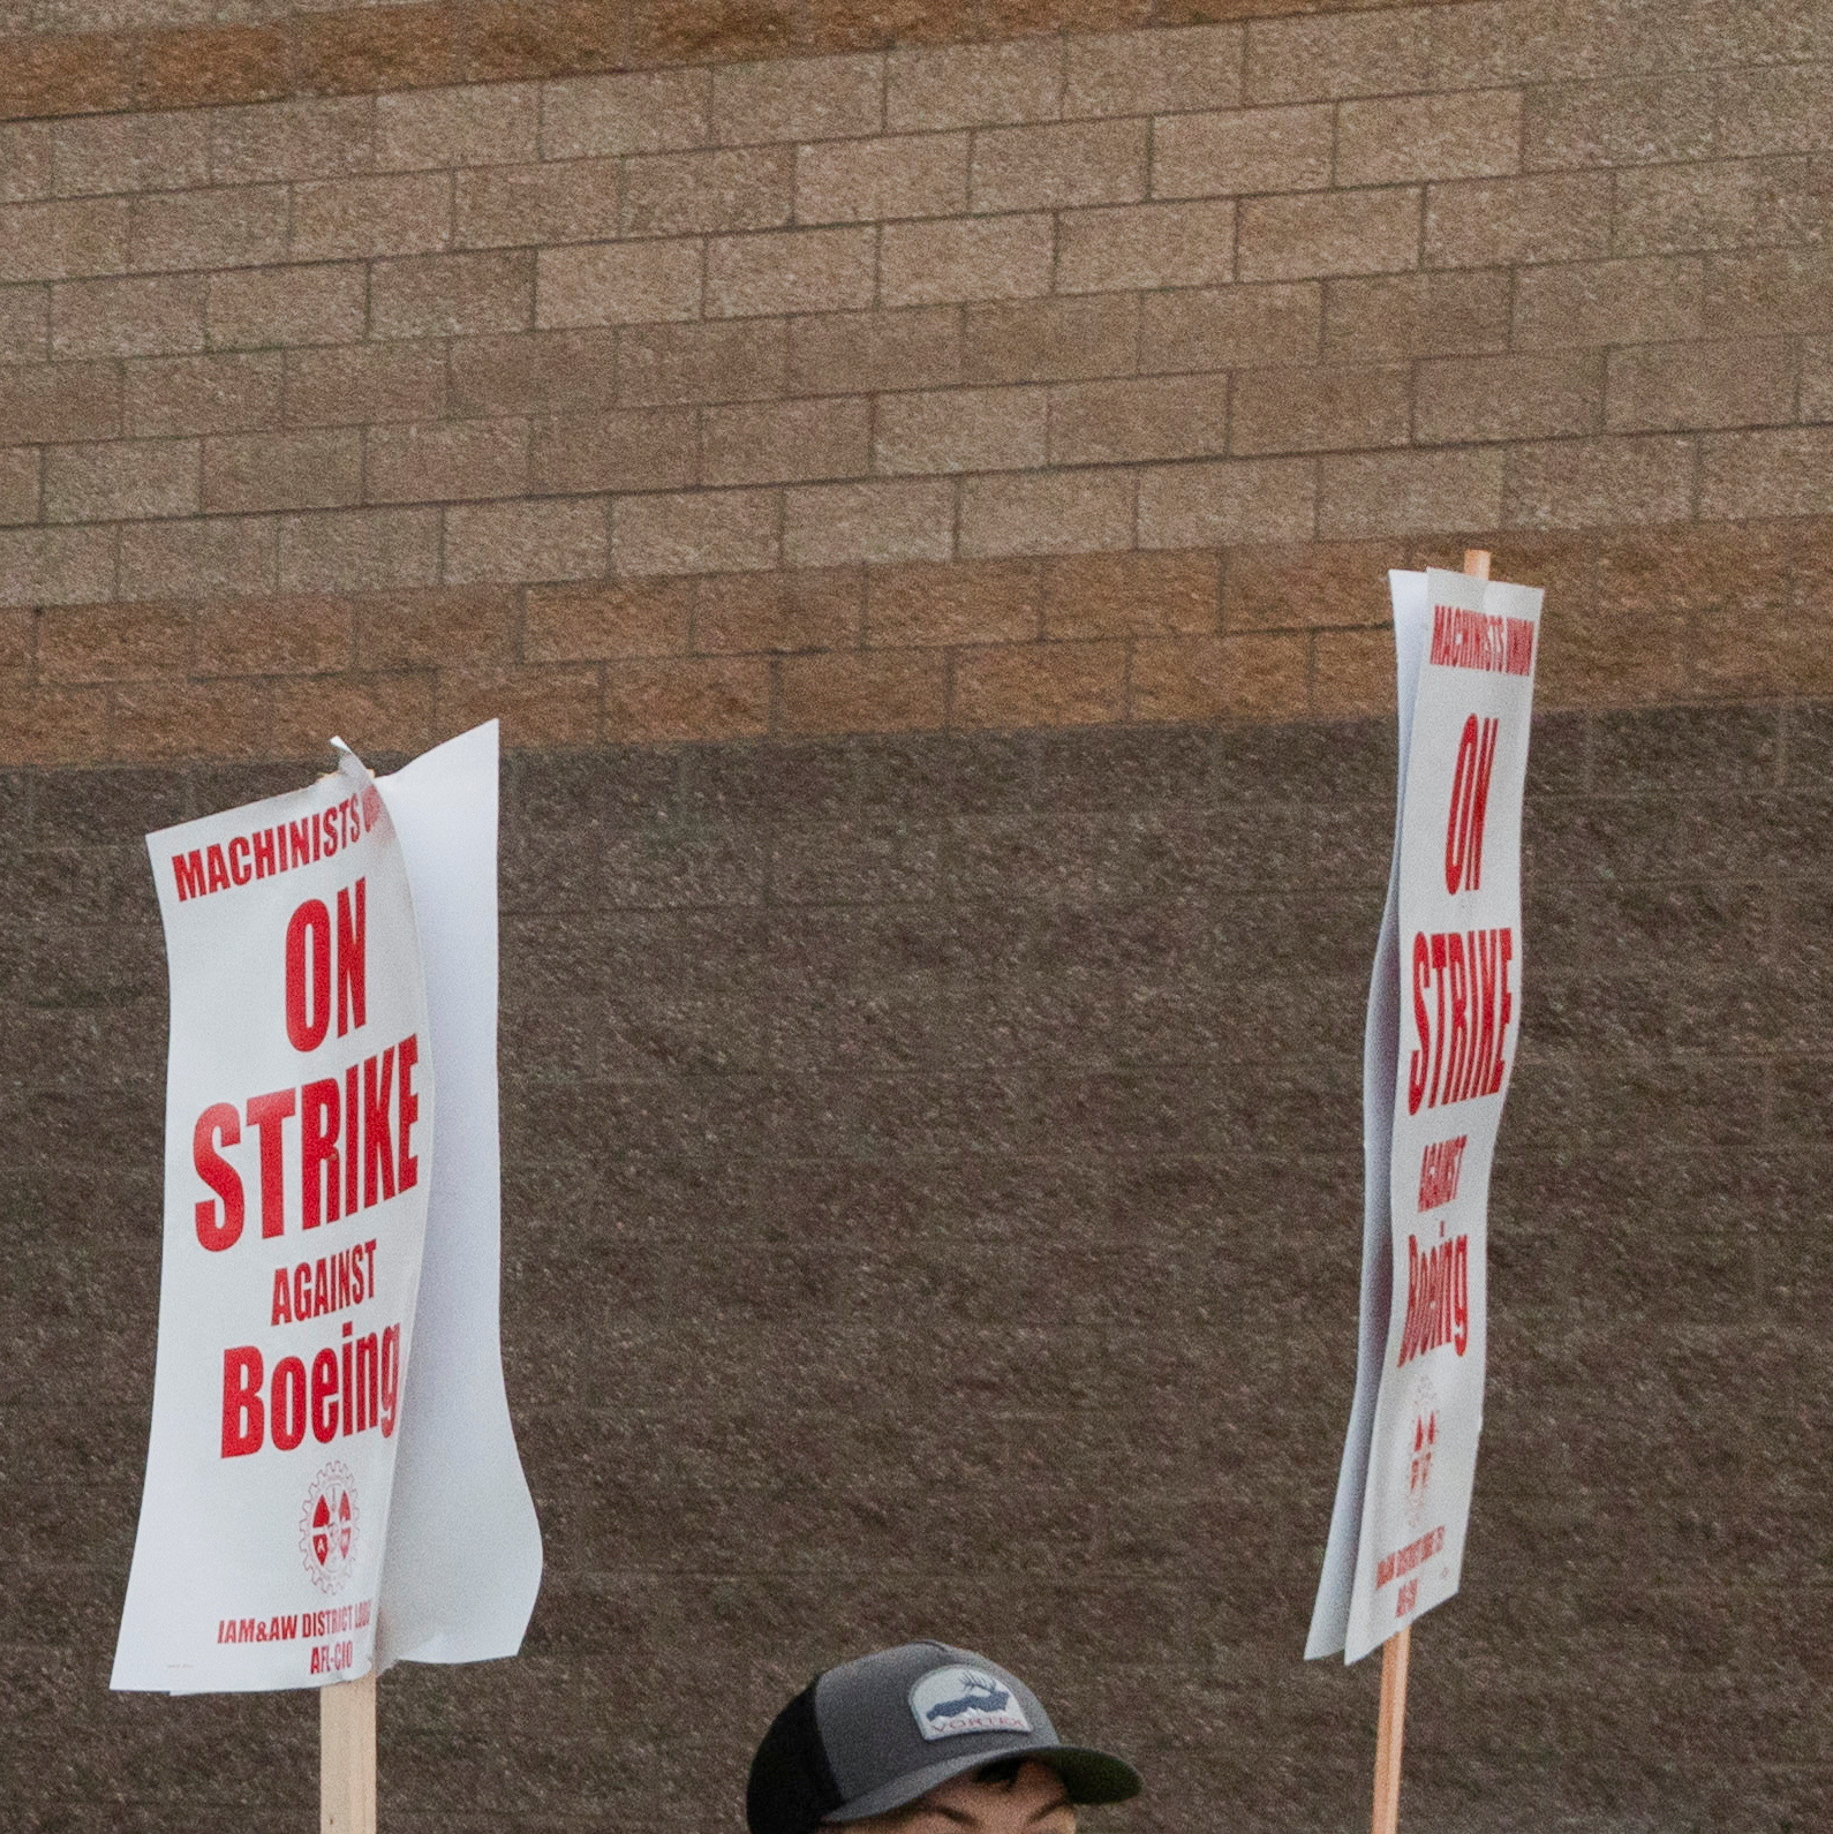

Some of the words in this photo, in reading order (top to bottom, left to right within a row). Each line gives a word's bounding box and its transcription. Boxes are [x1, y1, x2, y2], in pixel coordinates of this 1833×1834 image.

[172, 795, 360, 901] MACHINISTS
[1445, 714, 1498, 895] ON
[285, 877, 366, 1052] ON
[1408, 928, 1513, 1115] STRIKE
[193, 1035, 418, 1252] STRIKE
[272, 1240, 377, 1325] AGAINST
[221, 1323, 399, 1459] Boeing
[218, 1617, 297, 1642] IAM&AW
[302, 1605, 352, 1638] DISTRICT
[310, 1641, 353, 1675] AFL-CIO
